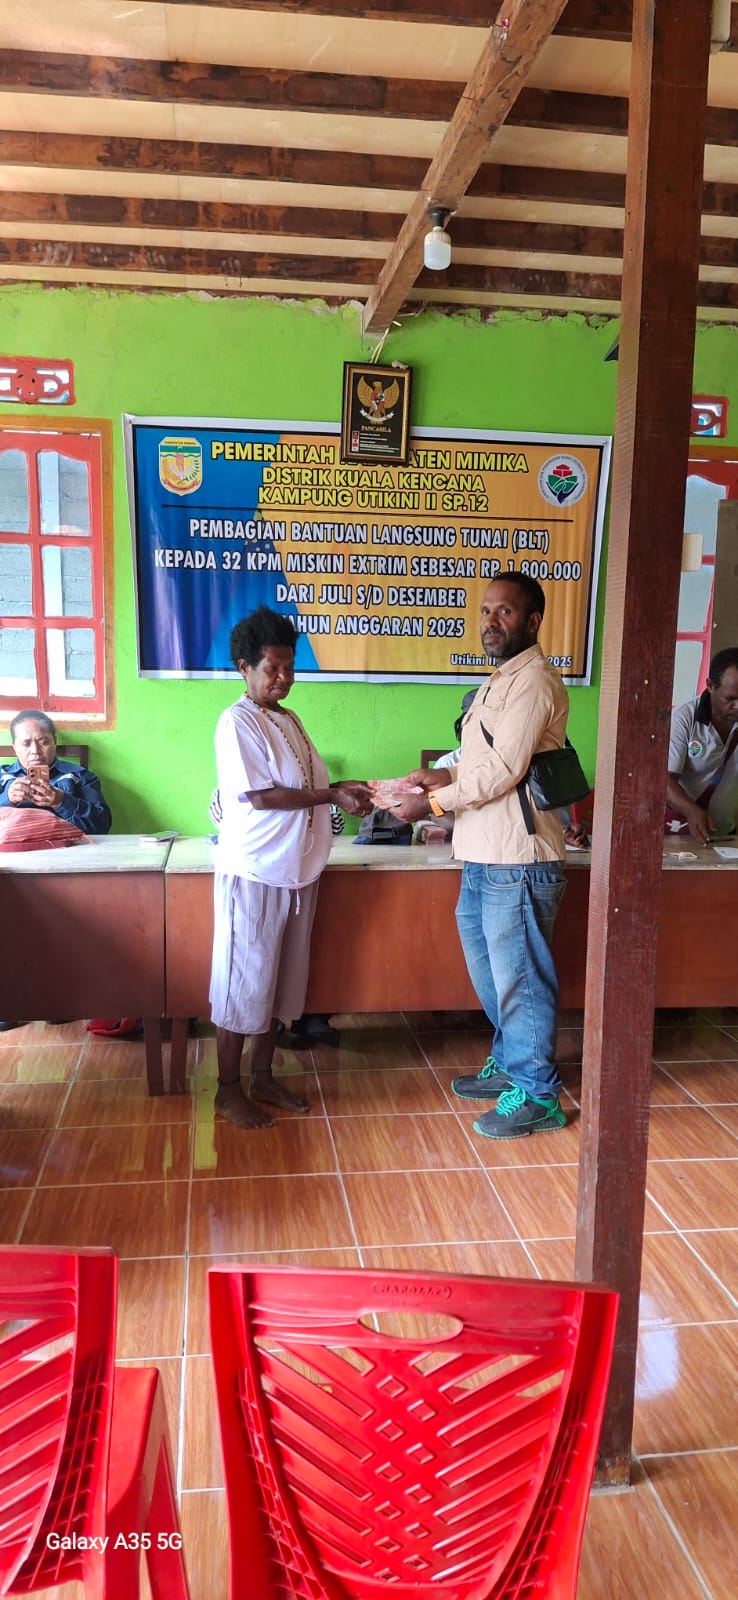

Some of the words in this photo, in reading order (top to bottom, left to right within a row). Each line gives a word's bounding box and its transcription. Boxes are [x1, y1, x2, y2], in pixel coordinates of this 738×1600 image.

[211, 441, 334, 464] PEMERINTAH
[456, 452, 529, 472] MIMIKA
[262, 467, 330, 486] DISTRIK
[335, 470, 394, 488] KUALA
[398, 473, 485, 492] KENCANA
[258, 487, 352, 507] KAMPUNG
[357, 490, 418, 509] UTIKINI
[426, 493, 437, 510] II
[442, 494, 489, 512] SP.12
[189, 519, 285, 541] PEMBAGIAN
[291, 521, 367, 543] BANTUAN
[372, 525, 455, 546] LANGSUNG
[461, 528, 508, 549] TUNAI
[512, 530, 550, 553] (BLT)
[154, 549, 216, 569] KEPADA
[222, 551, 241, 570] 32
[247, 552, 282, 572] KPM
[286, 553, 344, 574] MISKIN
[349, 555, 407, 576] EXTRIM
[411, 557, 476, 577] SEBESAR
[507, 559, 582, 580] 1800.000
[276, 584, 314, 604] DARI
[319, 584, 352, 604] JULI
[357, 585, 383, 609] S/D
[387, 587, 467, 608] DESEMBER
[334, 615, 423, 636] ANGGARAN
[427, 618, 465, 637] 2025
[450, 653, 486, 666] Utikini
[547, 656, 573, 668] 2025
